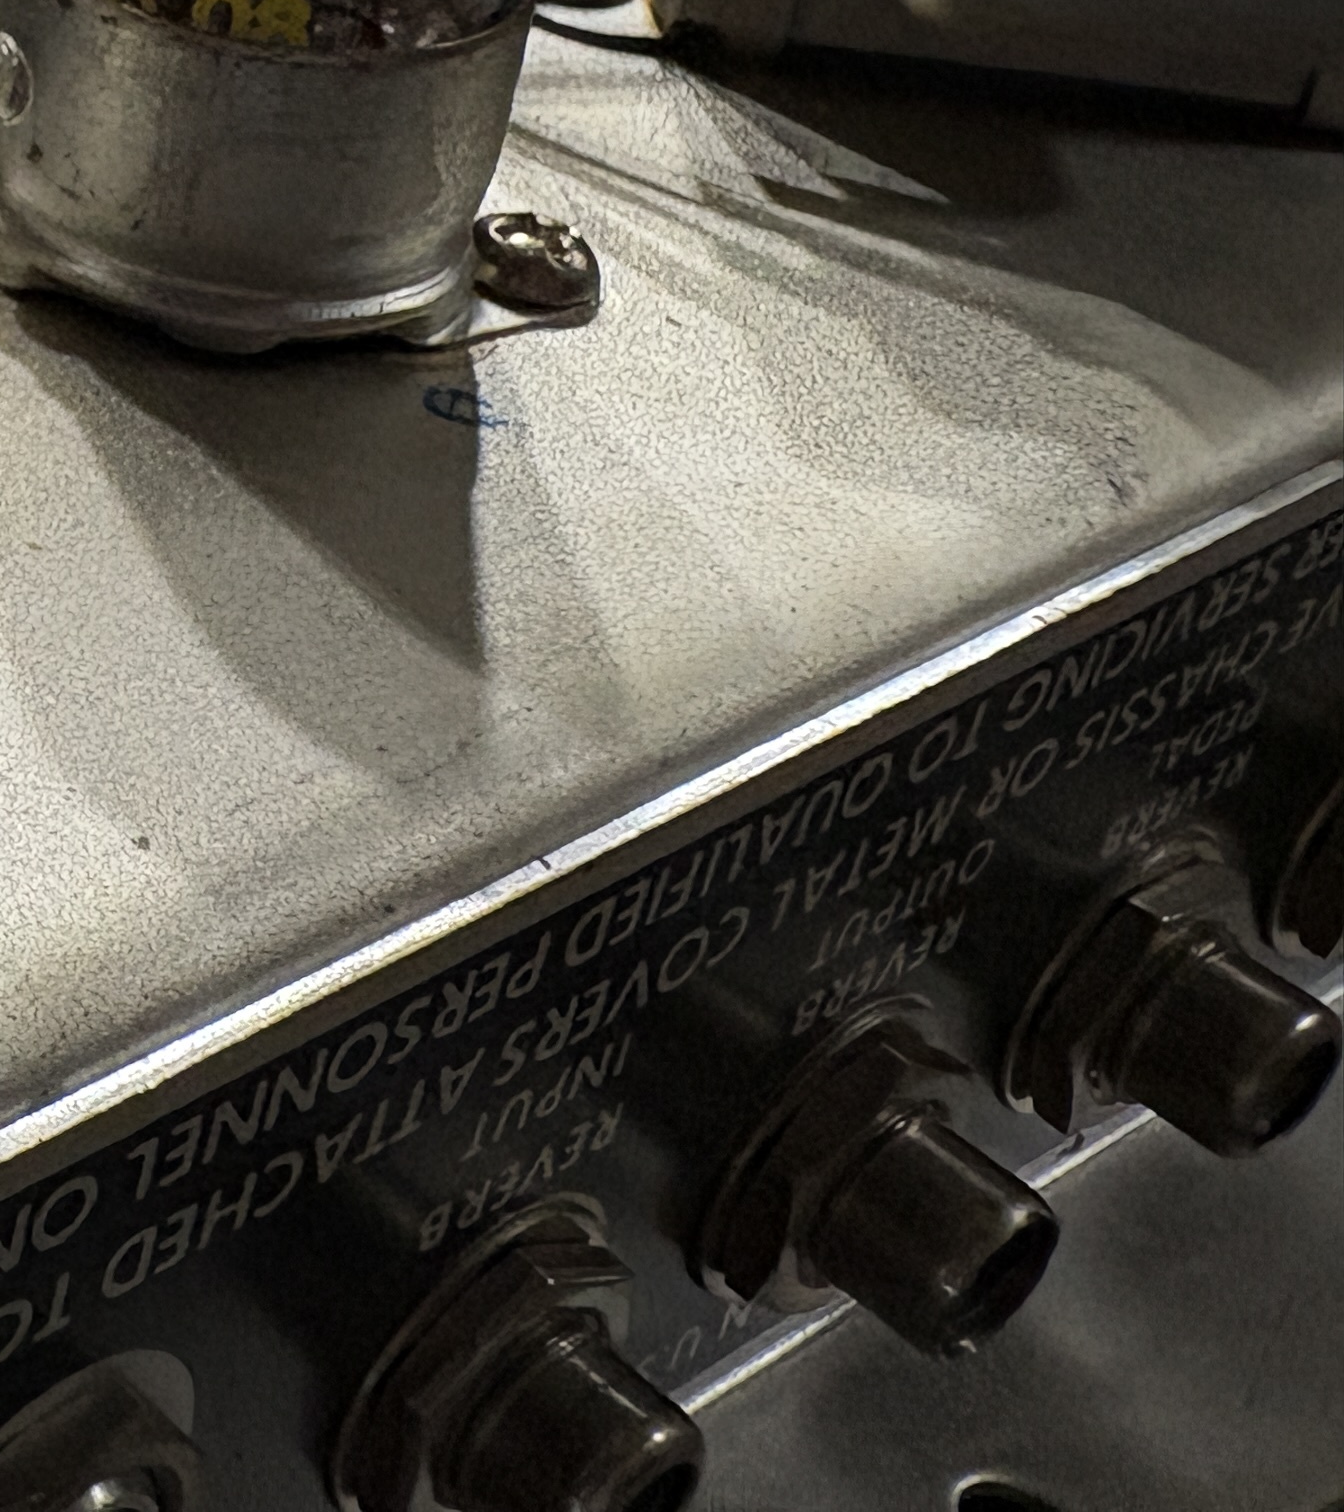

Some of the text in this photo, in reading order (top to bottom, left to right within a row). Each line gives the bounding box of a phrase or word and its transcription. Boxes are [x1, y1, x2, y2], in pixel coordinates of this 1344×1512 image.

[1008, 544, 1289, 731] SERVICING
[1065, 621, 1274, 769] CHASSIS
[911, 700, 987, 783] TO
[976, 739, 1056, 819] OR
[1149, 682, 1266, 779] PEDAL
[568, 753, 891, 966] QUALIFIED
[772, 785, 964, 931] METAL
[805, 839, 993, 974] OUTPUT
[493, 907, 746, 1086] COVERS
[793, 916, 962, 1034] REVERB
[128, 932, 550, 1200] PERSONNEL
[460, 1036, 629, 1162] INPUT
[102, 1048, 483, 1298] ATTACHED
[421, 1105, 621, 1249] REVERB
